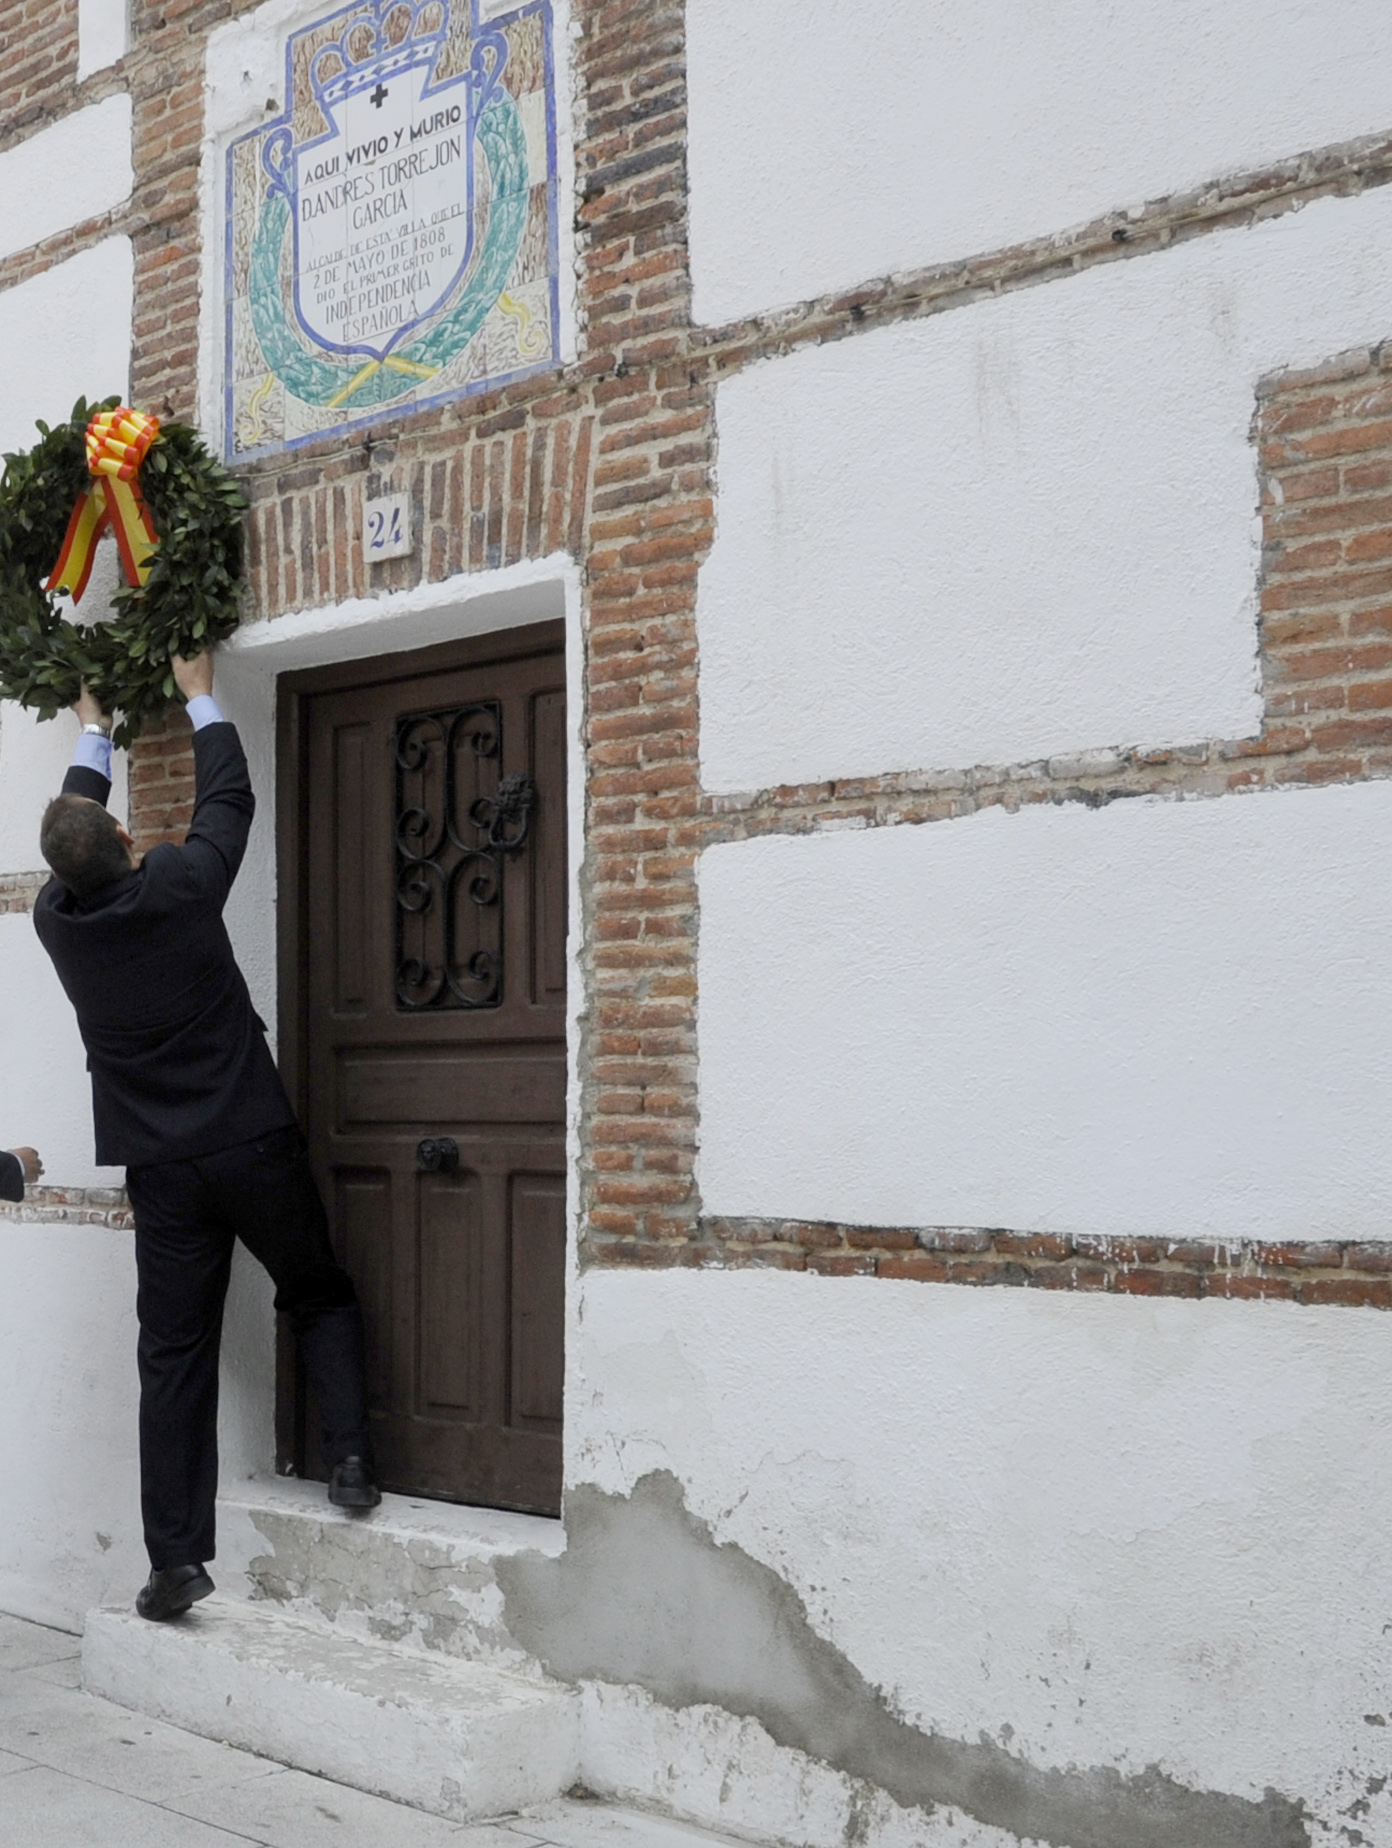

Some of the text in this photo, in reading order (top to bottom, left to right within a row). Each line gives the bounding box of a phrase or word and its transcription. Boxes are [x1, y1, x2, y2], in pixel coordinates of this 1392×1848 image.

[304, 105, 461, 185] AQUI VIVIO Y MURIO
[379, 135, 461, 190] TORREJON
[352, 188, 408, 230] GARCIA
[450, 202, 465, 219] EL
[313, 226, 446, 290] 2 DE MAYO DE 1808
[316, 243, 454, 304] DIO EL PRIMER GRITO DE
[326, 269, 431, 325] INDEPENDENCIA
[342, 299, 420, 342] ESPAÑOLA
[368, 507, 403, 549] 24
